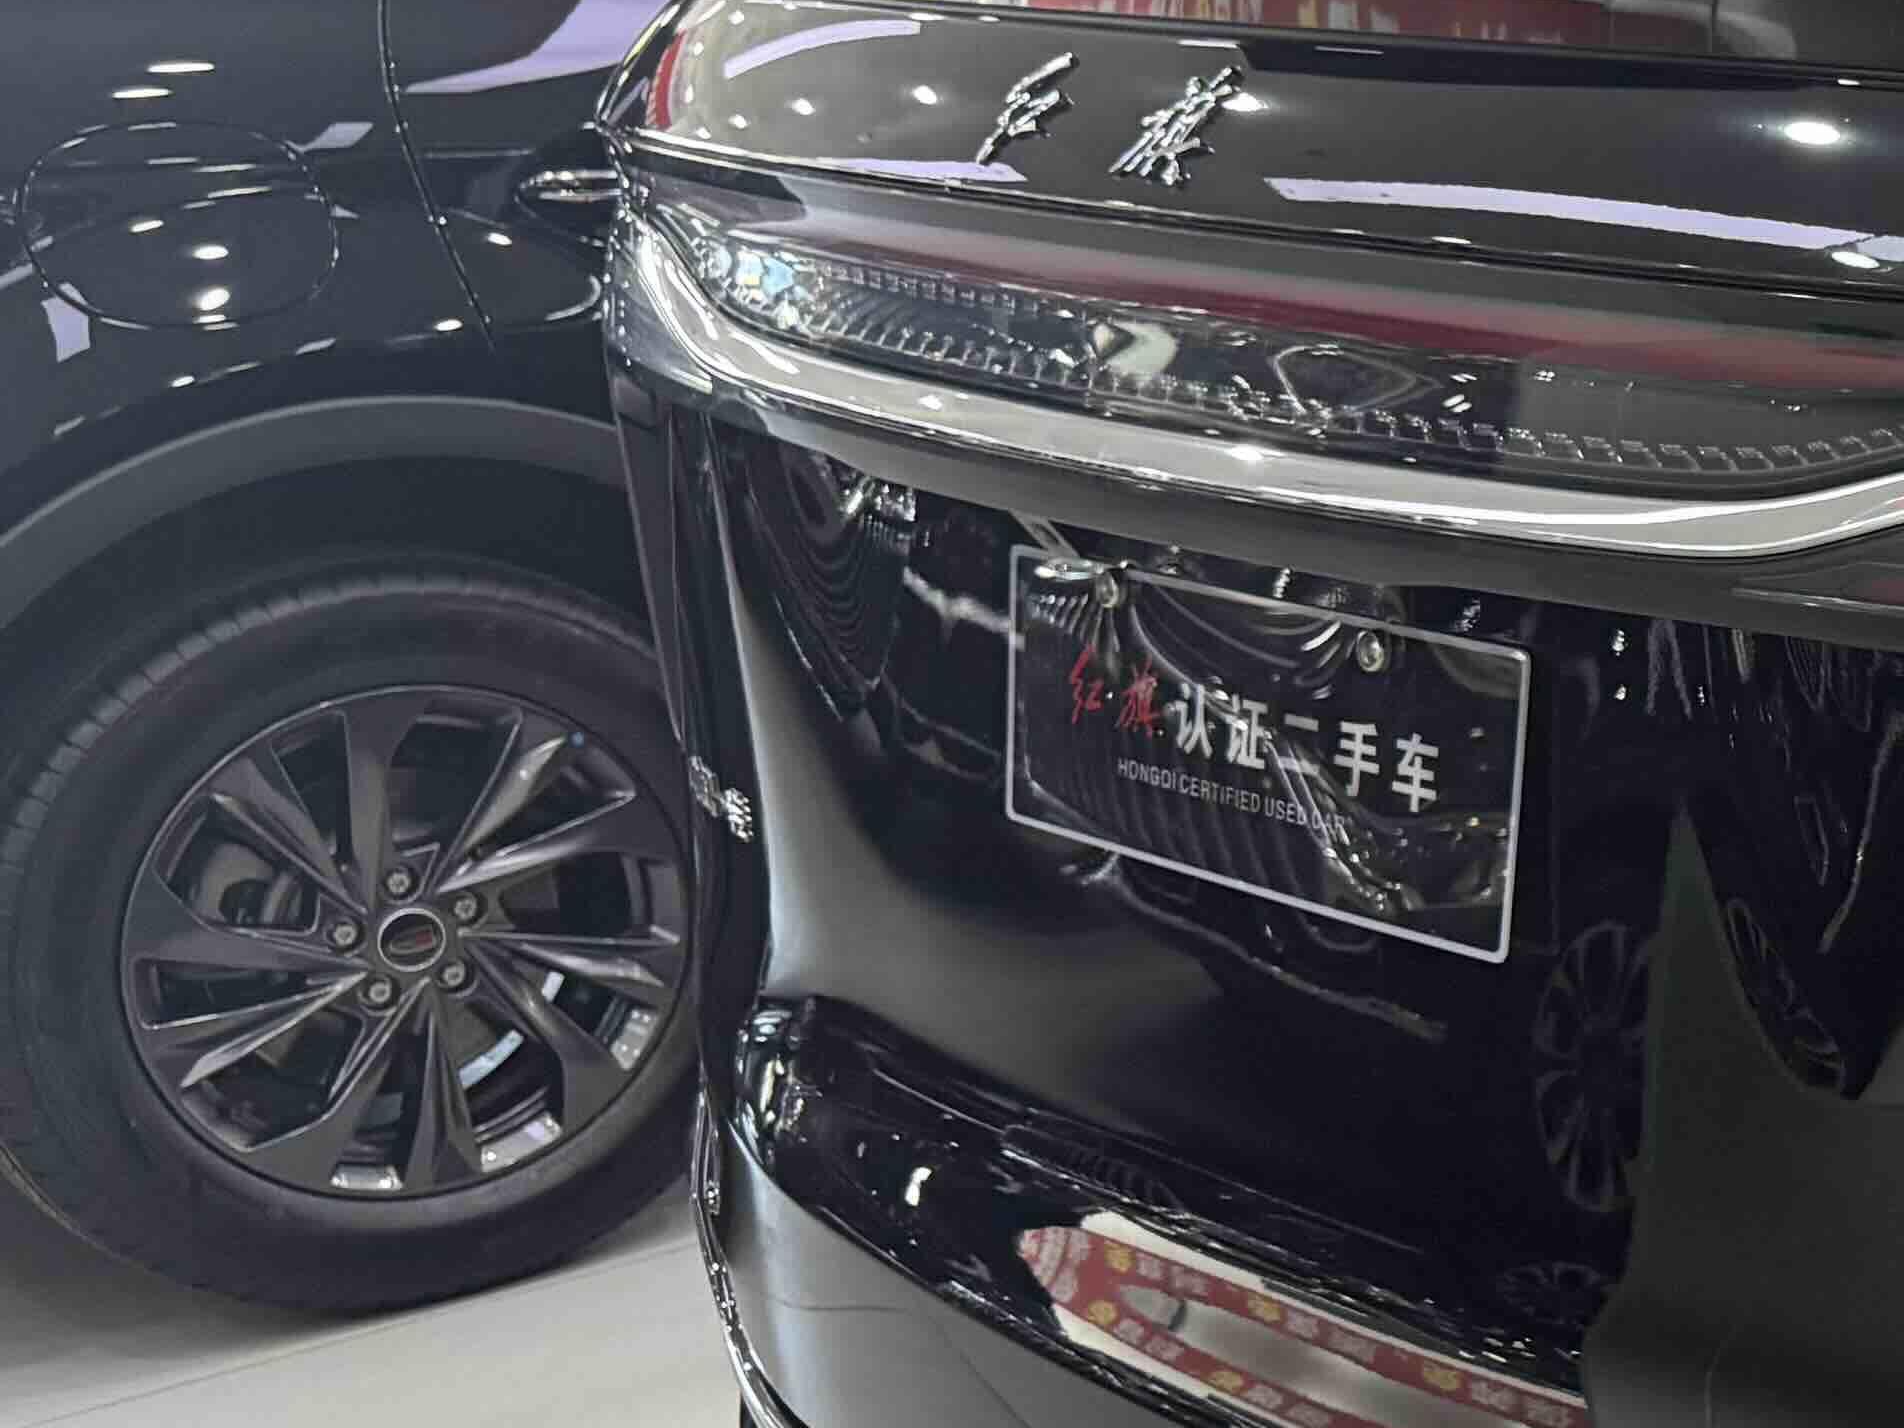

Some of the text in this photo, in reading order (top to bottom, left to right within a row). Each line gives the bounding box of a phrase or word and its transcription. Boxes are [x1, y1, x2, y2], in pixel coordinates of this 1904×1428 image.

[1116, 757, 1177, 790] HONGQI
[1178, 774, 1261, 814] CERTIFIED
[1264, 798, 1308, 829] USED
